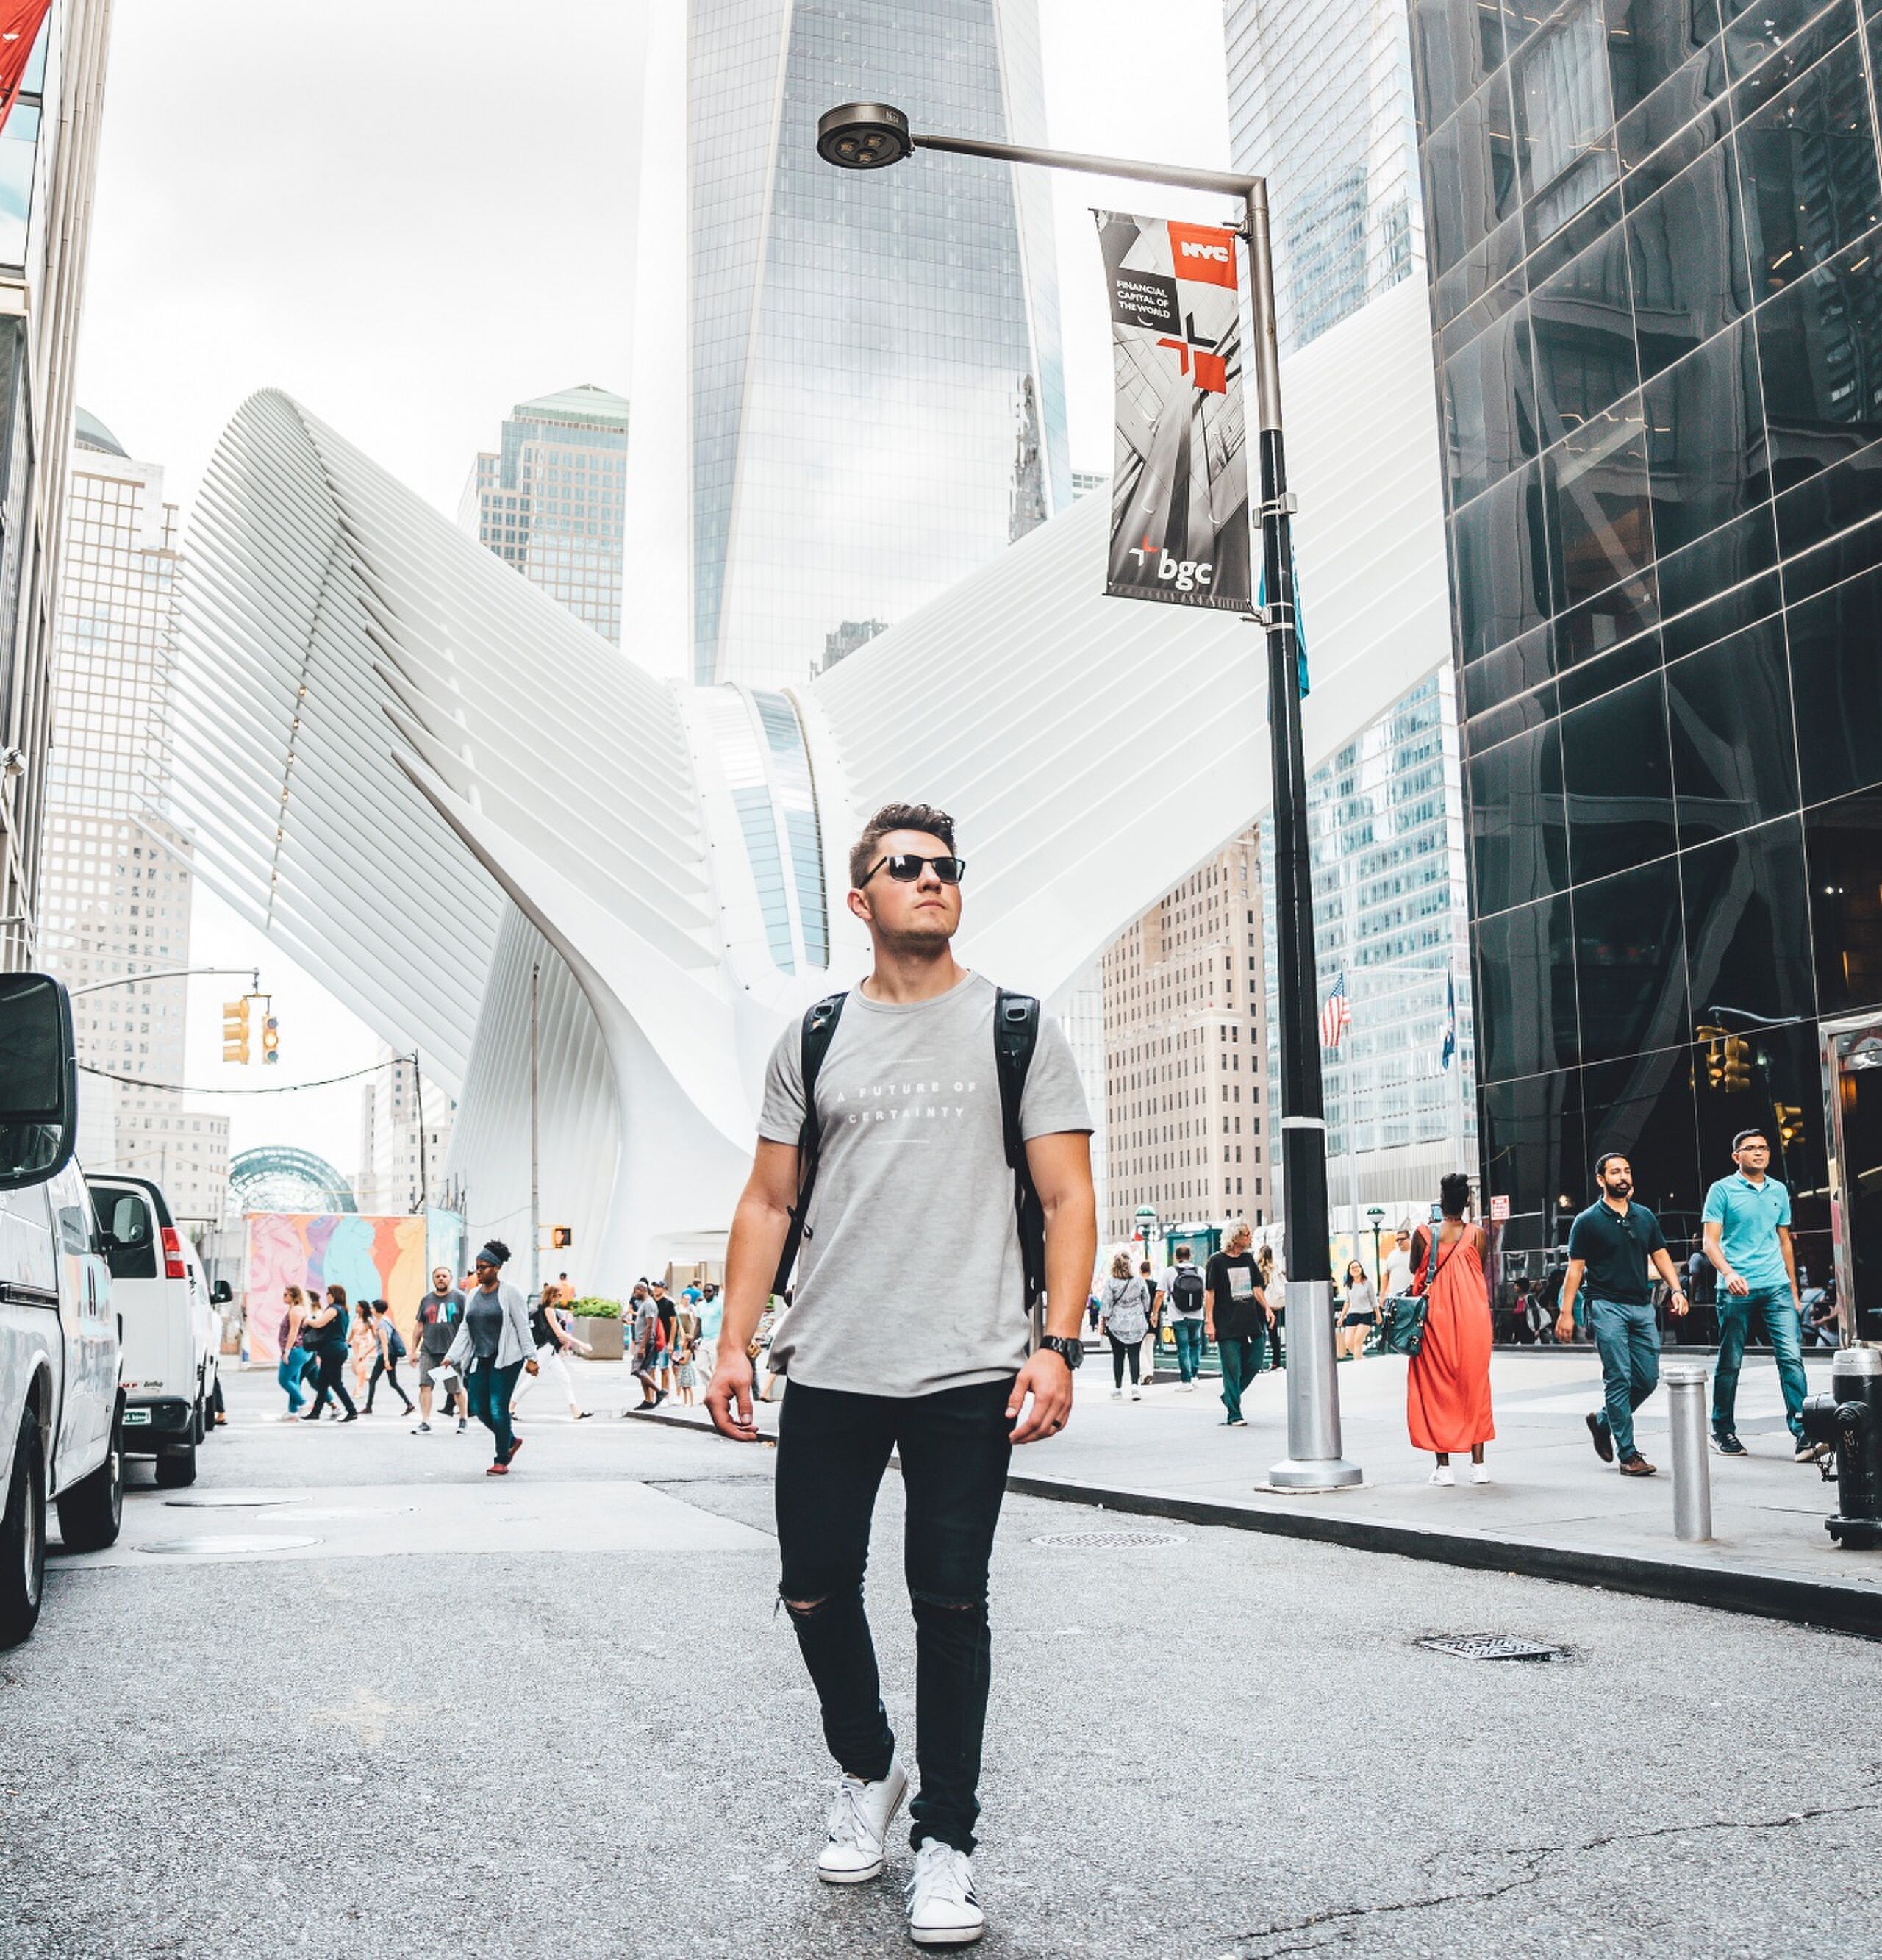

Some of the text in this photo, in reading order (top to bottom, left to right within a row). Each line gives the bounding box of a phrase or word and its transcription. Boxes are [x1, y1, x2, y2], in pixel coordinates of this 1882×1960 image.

[1181, 241, 1228, 262] NYC
[1117, 280, 1168, 298] FINANCIAL
[1117, 290, 1169, 307] CAPITAL OF
[1118, 301, 1170, 318] THE WORLD
[1158, 548, 1212, 591] bgc
[837, 1081, 976, 1102] A FUTURE OF
[849, 1106, 963, 1123] CERTAINTY
